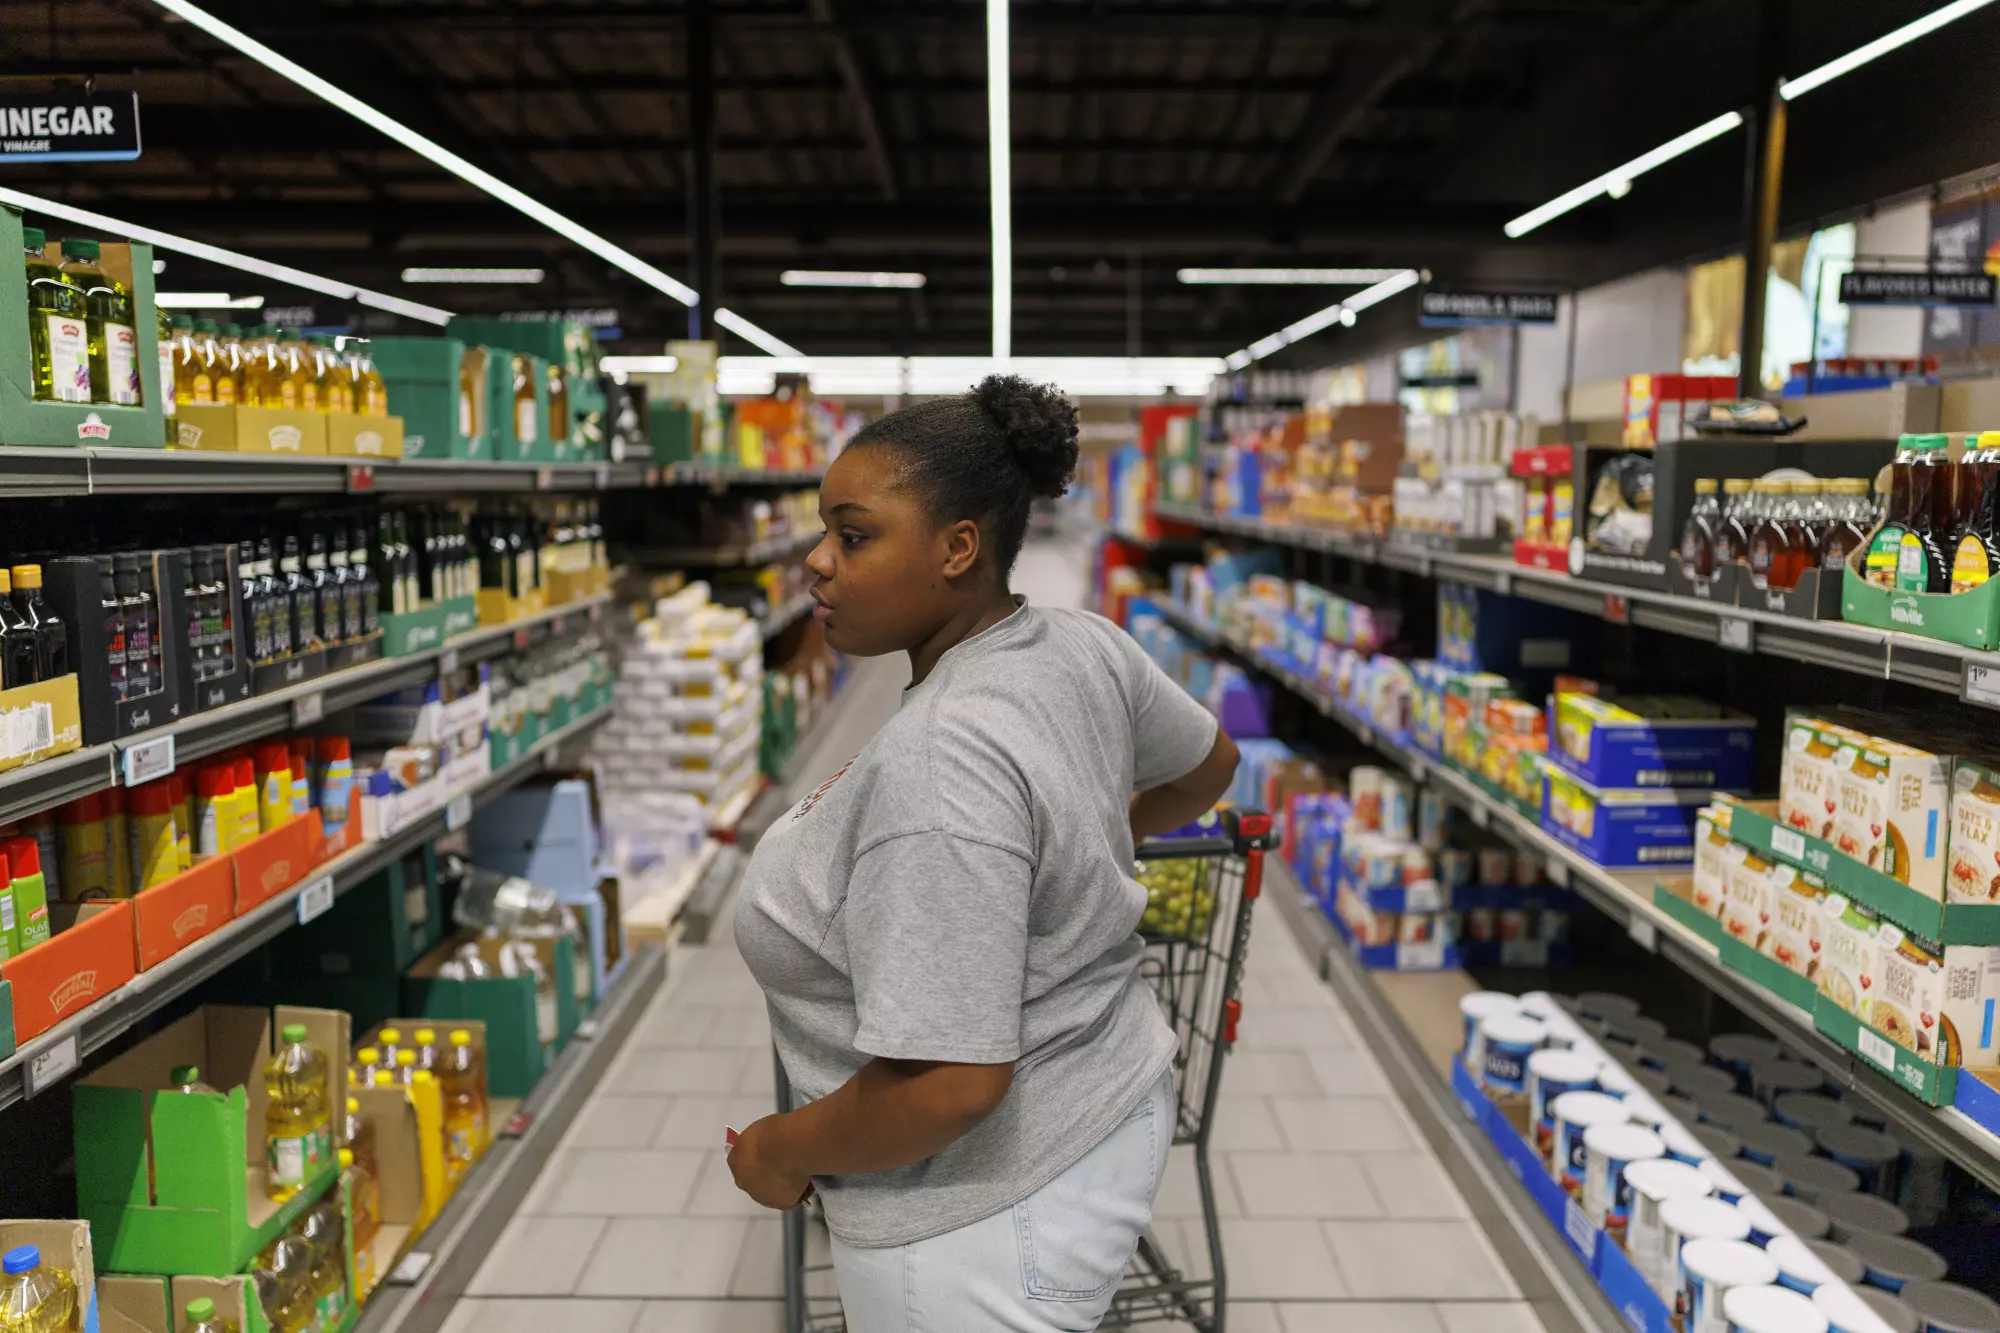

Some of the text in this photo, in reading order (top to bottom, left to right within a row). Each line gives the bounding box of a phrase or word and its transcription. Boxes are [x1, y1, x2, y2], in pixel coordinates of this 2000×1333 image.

[0, 106, 116, 136] INEGAR
[1959, 807, 1981, 827] OATS
[1961, 822, 1988, 845] FLAX
